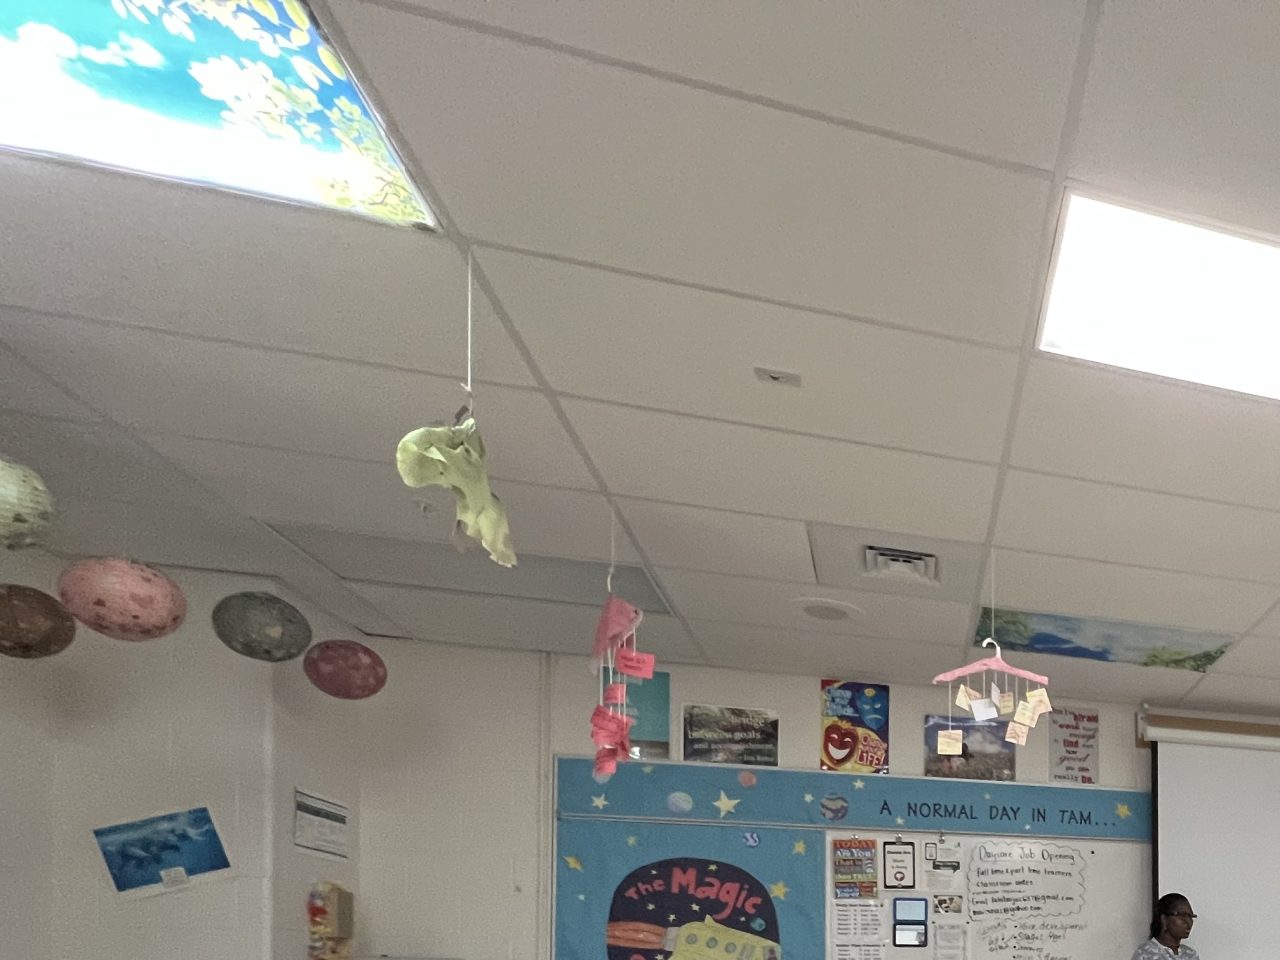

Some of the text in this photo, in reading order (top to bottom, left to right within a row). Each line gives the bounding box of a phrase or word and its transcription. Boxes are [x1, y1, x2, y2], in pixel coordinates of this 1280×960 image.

[734, 729, 761, 741] goals
[879, 800, 892, 816] A
[907, 802, 978, 821] NORMAL
[989, 805, 1021, 822] DAY
[1032, 808, 1046, 823] IN
[1020, 847, 1036, 859] Job
[624, 867, 762, 920] The Magic
